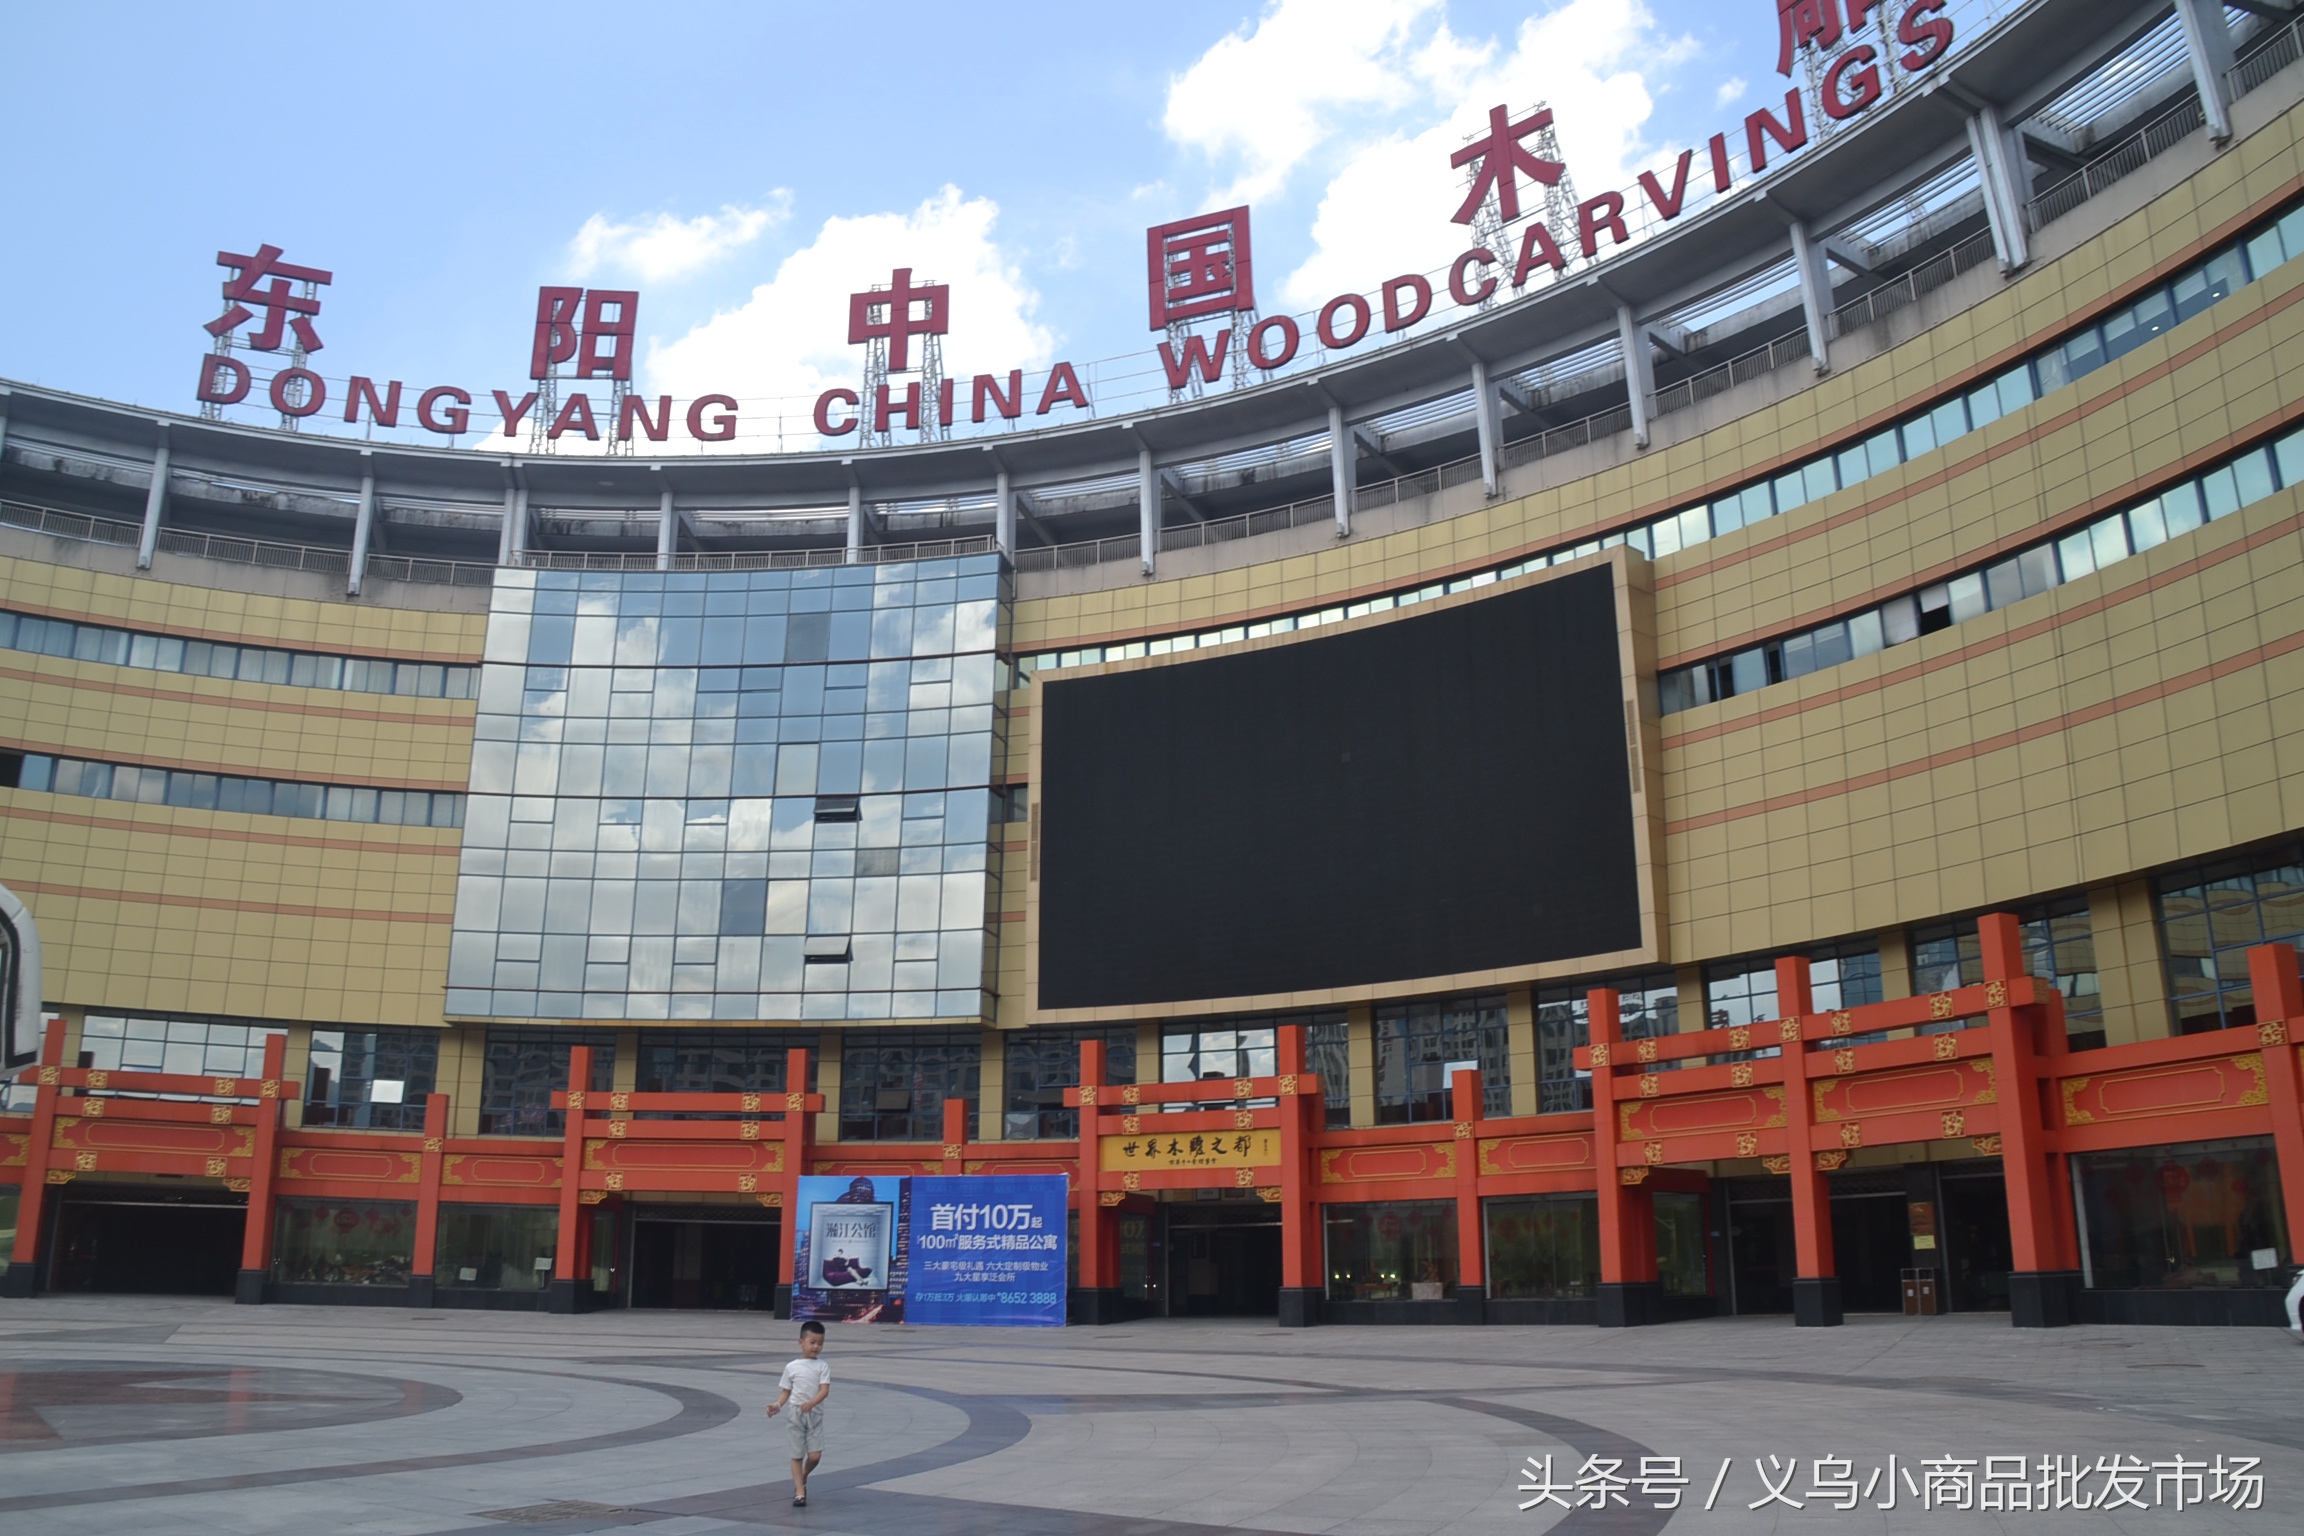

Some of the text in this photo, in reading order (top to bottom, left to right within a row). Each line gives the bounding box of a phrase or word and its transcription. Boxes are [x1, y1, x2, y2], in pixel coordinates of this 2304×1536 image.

[197, 353, 739, 442] DONGYANG
[813, 361, 1089, 436] CHINA
[1157, 0, 1955, 391] WOODCARVINGS
[930, 1203, 1043, 1231] 首付10万起
[1000, 1292, 1027, 1304] 8652
[1029, 1292, 1057, 1304] 3888
